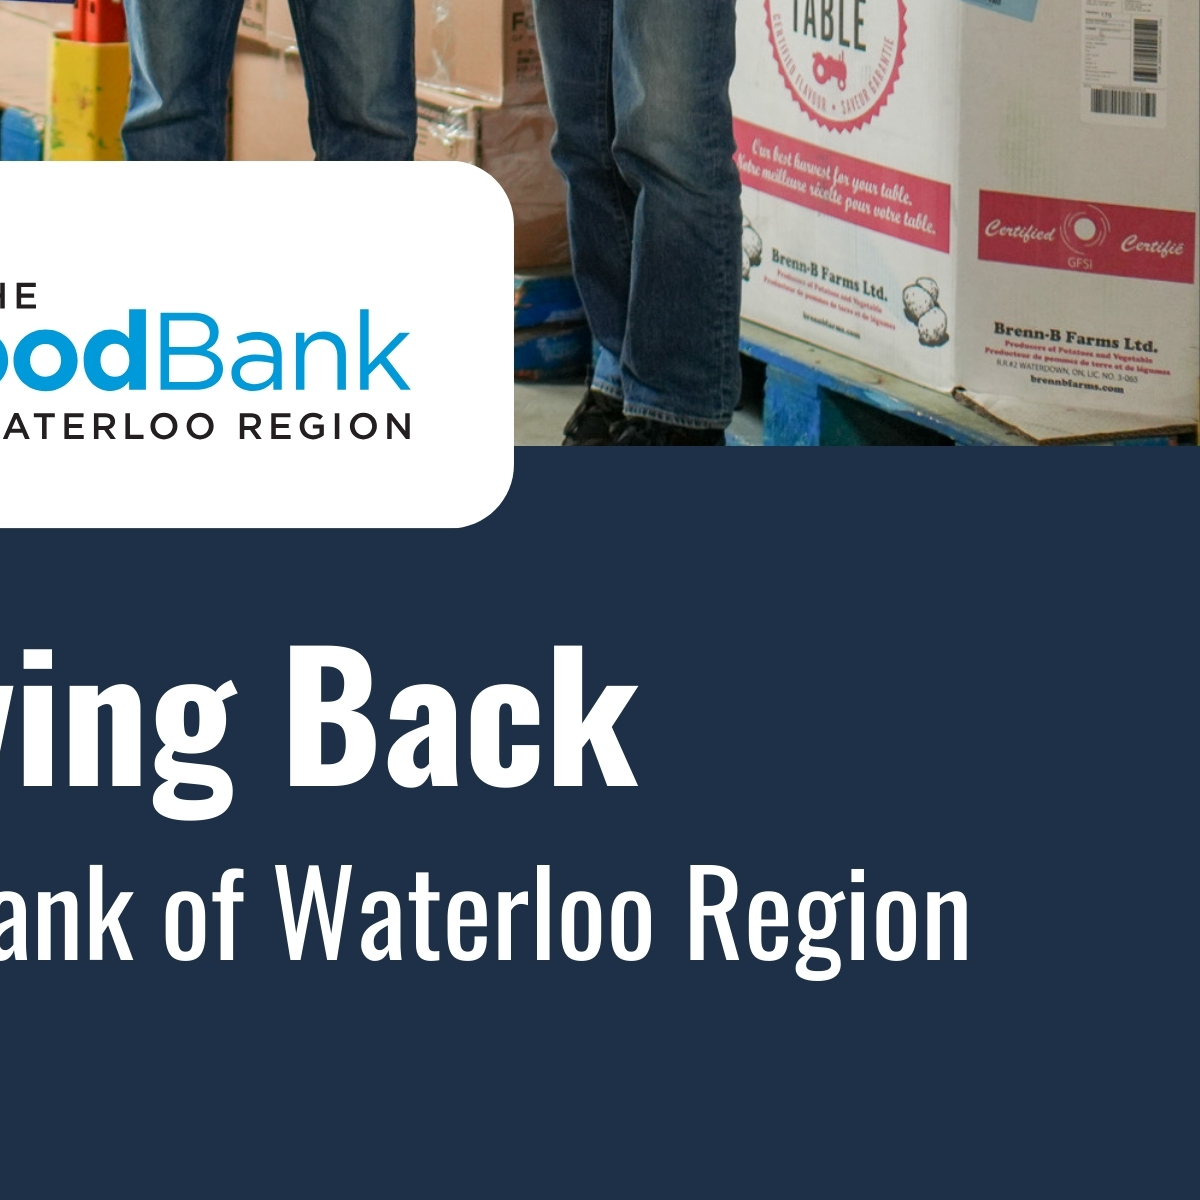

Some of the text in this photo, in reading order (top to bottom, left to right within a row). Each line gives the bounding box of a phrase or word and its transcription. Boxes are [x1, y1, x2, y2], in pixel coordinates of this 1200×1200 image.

[841, 88, 871, 116] SAVEUR
[867, 36, 895, 94] GARANTIE
[752, 137, 913, 206] Our best harvest for your table.
[761, 167, 807, 193] meilleure
[809, 181, 843, 205] récolte
[844, 196, 871, 215] pour
[873, 205, 902, 225] votre
[903, 211, 937, 235] table.
[984, 218, 1057, 243] Certified
[1120, 233, 1184, 259] Certifié
[771, 247, 888, 302] Brenn-B Farms Ltd.
[994, 321, 1159, 354] Brenn-B Farms Ltd.
[1004, 339, 1154, 364] Producers of Potatoes and Vegetable
[1030, 374, 1125, 394] brennbfarms.com
